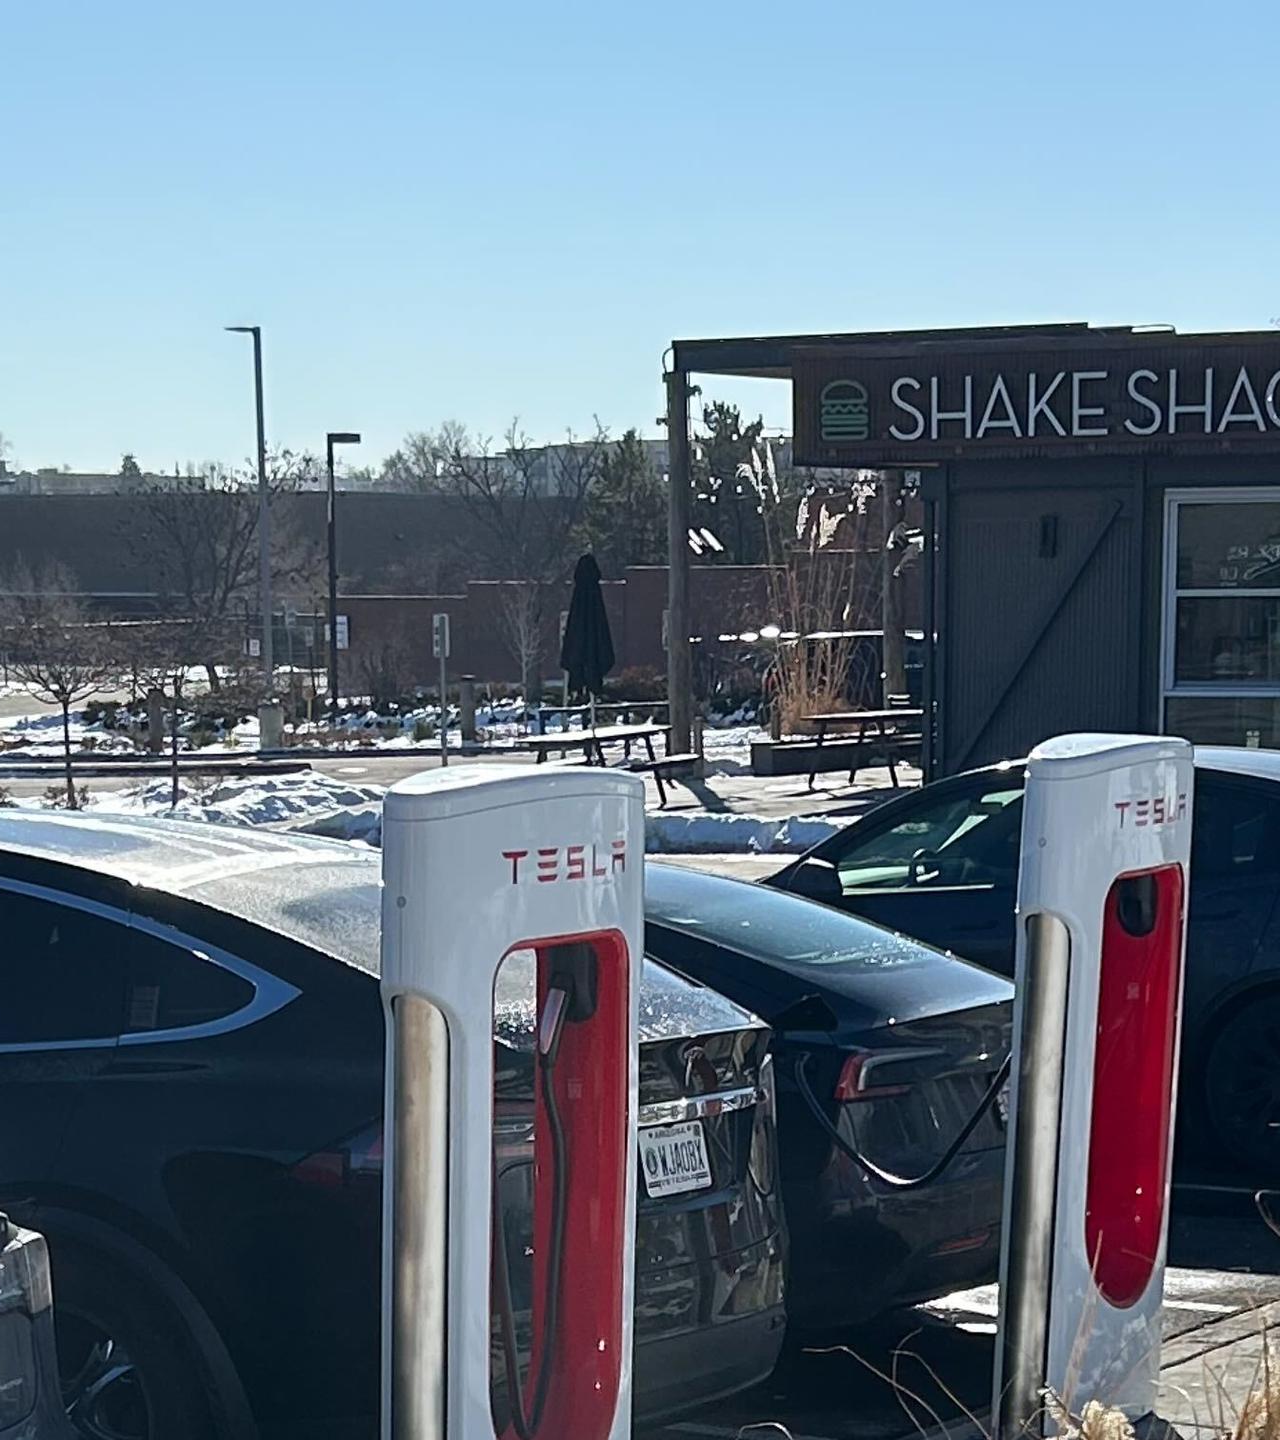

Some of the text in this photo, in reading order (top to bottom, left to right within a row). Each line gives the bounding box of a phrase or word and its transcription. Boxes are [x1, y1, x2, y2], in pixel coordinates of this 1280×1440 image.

[888, 371, 1109, 441] SHAKE
[1114, 793, 1187, 829] TESLA
[501, 839, 626, 885] TESLA
